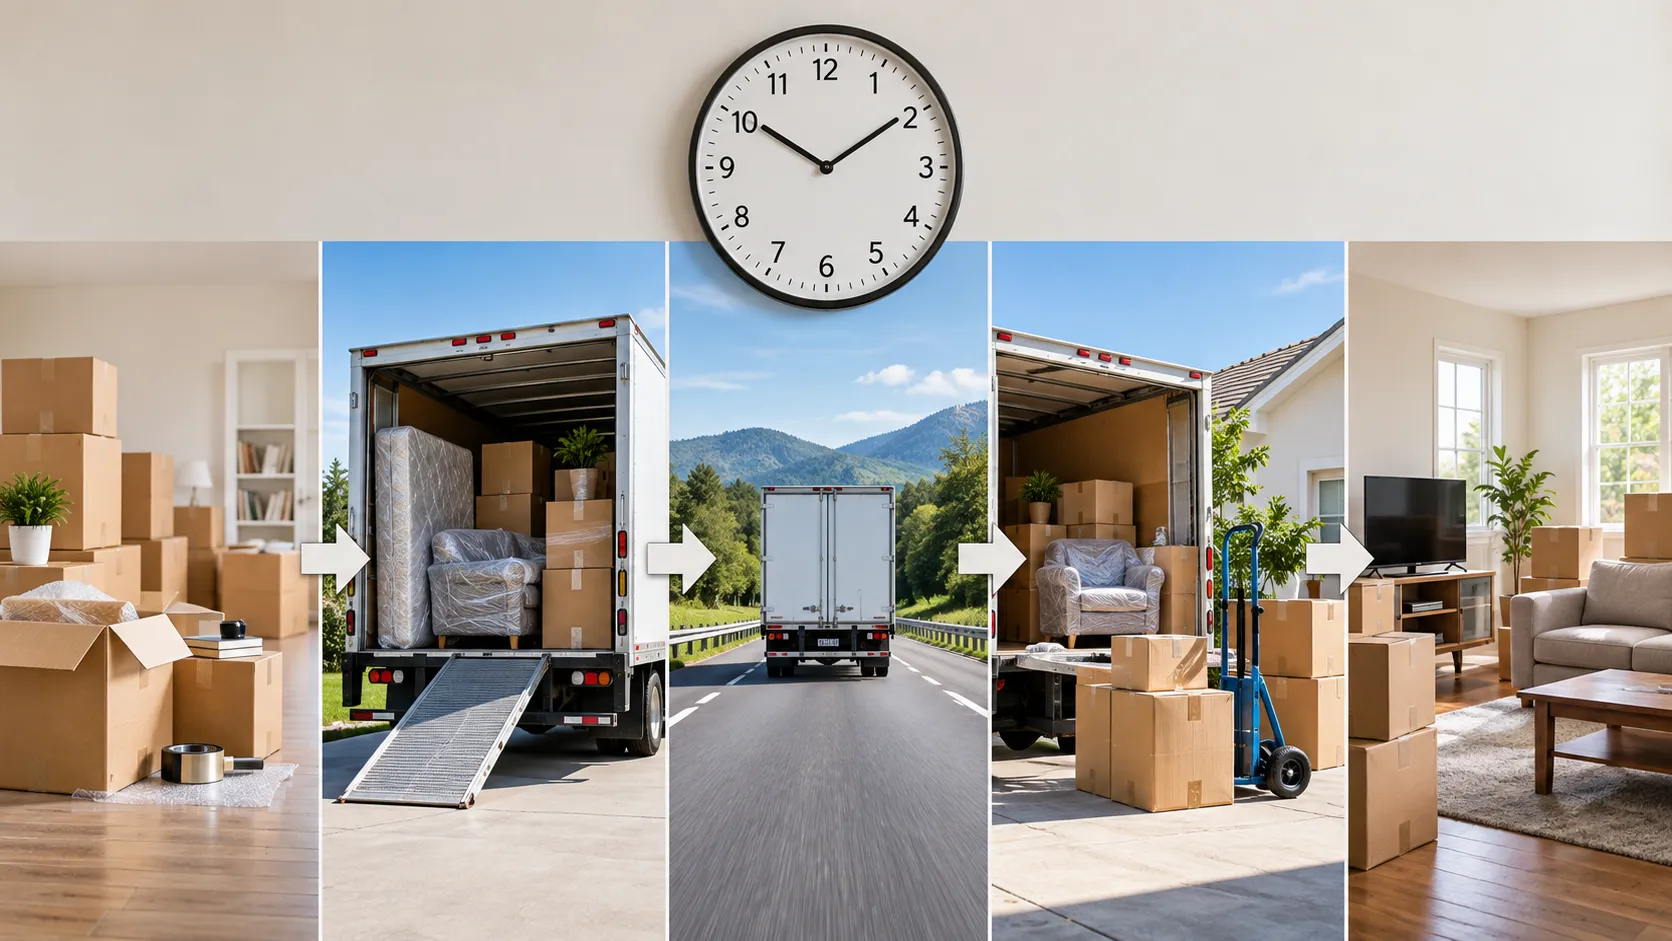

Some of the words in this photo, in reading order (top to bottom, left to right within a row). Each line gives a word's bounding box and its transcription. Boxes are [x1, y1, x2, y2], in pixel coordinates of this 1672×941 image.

[812, 58, 838, 81] 12
[767, 72, 787, 95] 11
[869, 71, 878, 95] 1
[731, 110, 758, 134] 10
[902, 105, 918, 129] 2
[719, 155, 735, 179] 9
[918, 155, 934, 179] 3
[734, 205, 750, 228] 8
[903, 205, 920, 228] 4
[771, 240, 786, 264] 7
[868, 241, 884, 265] 5
[818, 254, 835, 278] 6
